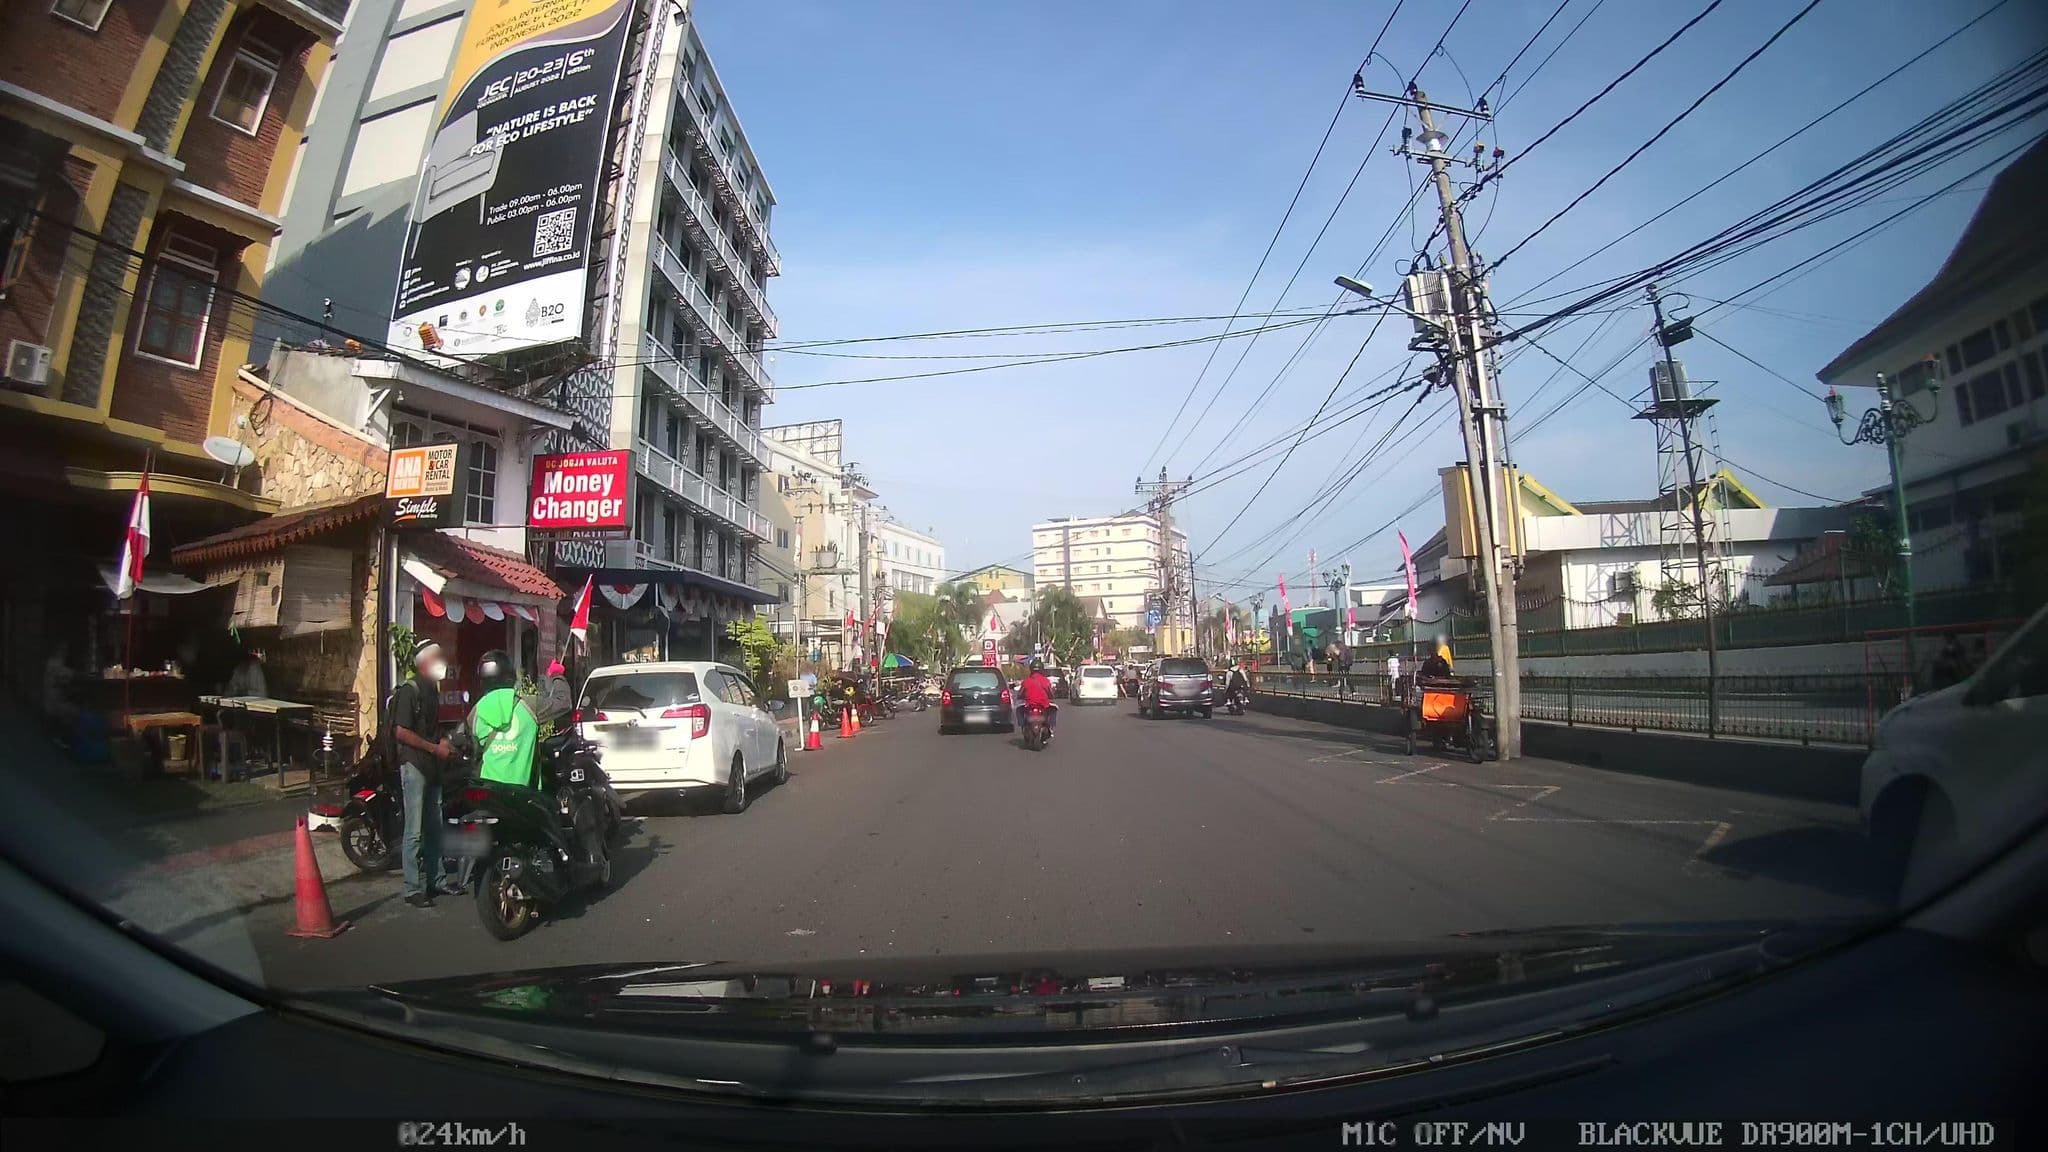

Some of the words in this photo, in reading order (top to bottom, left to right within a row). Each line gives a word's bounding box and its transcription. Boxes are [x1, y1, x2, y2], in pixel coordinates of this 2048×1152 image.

[489, 22, 545, 50] INDONESIA
[548, 8, 582, 26] 2022
[478, 76, 513, 101] JEC
[517, 58, 565, 84] 20-23
[568, 48, 595, 67] 6th
[543, 105, 556, 119] IS
[558, 94, 598, 114] BACK
[469, 139, 494, 157] FOR
[495, 130, 520, 148] ECO
[486, 213, 507, 226] Public
[507, 204, 540, 219] 03.00pm
[545, 194, 581, 208] 06.00pm
[489, 203, 508, 214] Trade
[508, 194, 541, 208] 09.00am
[547, 183, 583, 197] 06.00pm
[428, 449, 452, 460] MOTOR
[429, 460, 435, 470] &
[435, 460, 449, 469] CAR
[558, 458, 585, 468] JOGJA
[586, 456, 618, 466] VALUTA
[425, 470, 450, 481] RENTAL
[543, 471, 614, 497] Money
[395, 497, 437, 518] Simple
[532, 496, 623, 523] Changer
[491, 743, 518, 754] gojek
